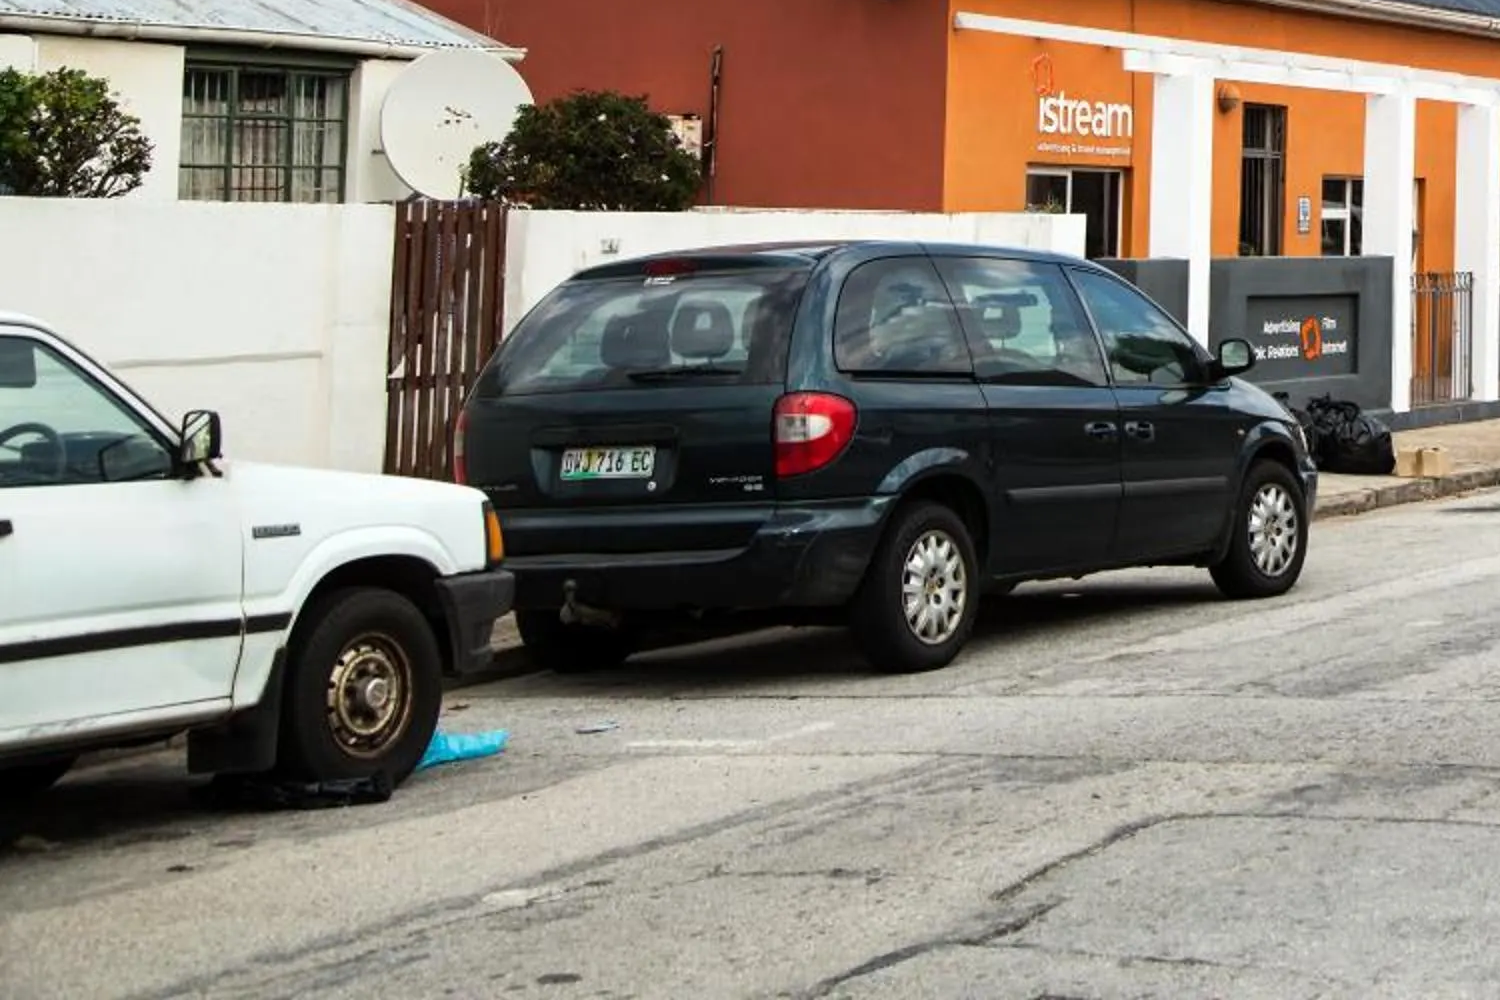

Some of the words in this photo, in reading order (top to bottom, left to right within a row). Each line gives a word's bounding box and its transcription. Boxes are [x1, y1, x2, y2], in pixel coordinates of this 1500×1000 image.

[1038, 90, 1132, 138] istream
[596, 450, 624, 473] 716
[631, 450, 651, 472] EC
